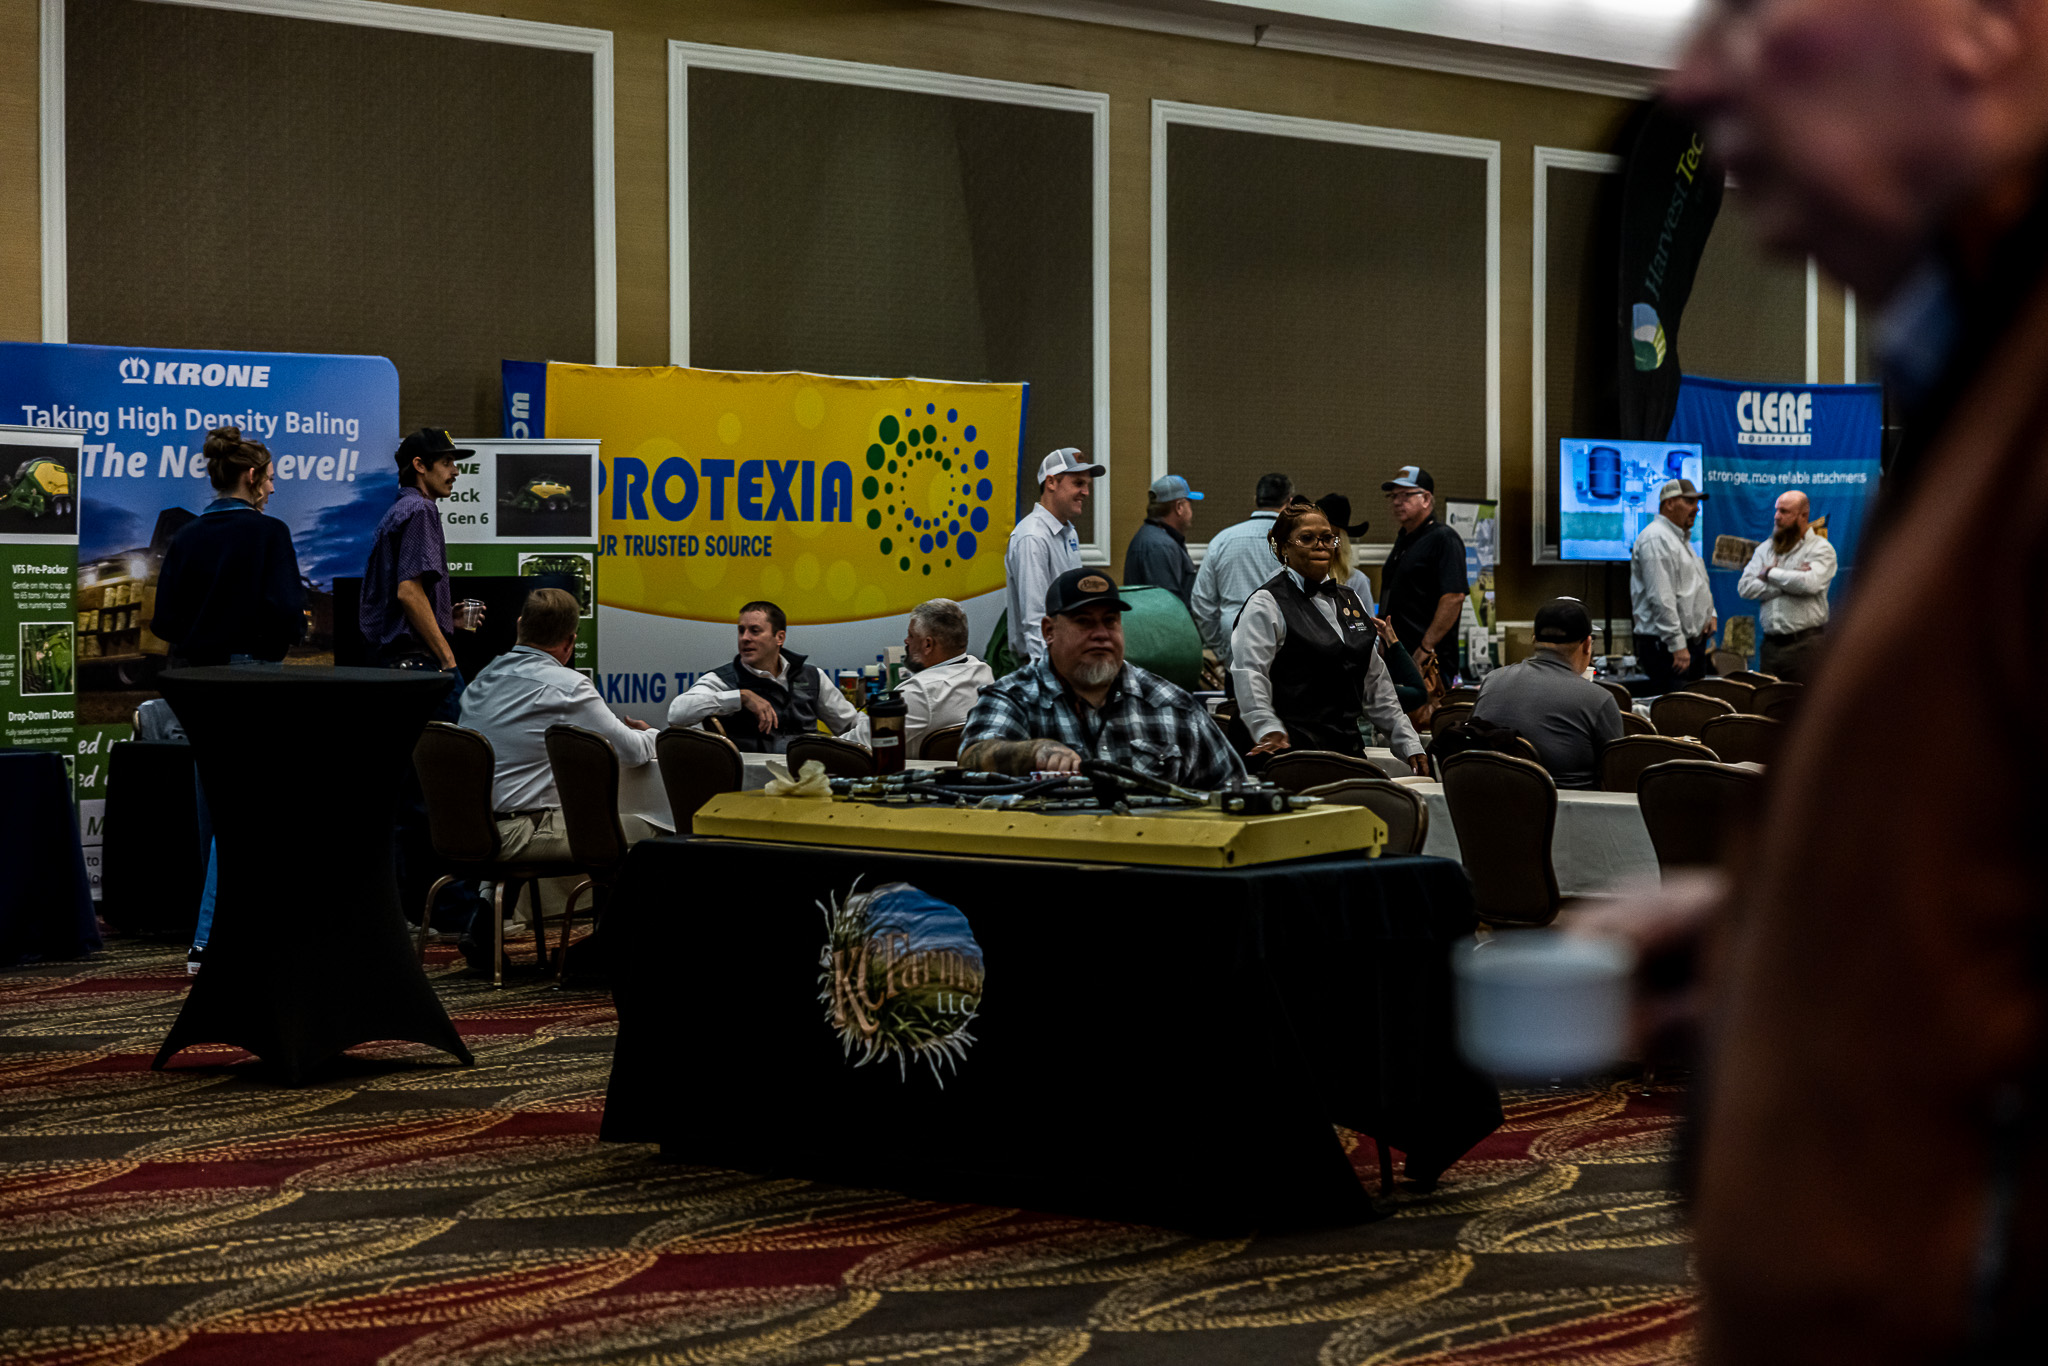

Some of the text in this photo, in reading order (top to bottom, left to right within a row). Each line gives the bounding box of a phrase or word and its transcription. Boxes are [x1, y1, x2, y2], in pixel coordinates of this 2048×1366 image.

[153, 362, 271, 388] KRONE
[1736, 390, 1812, 433] CLERF
[22, 405, 360, 442] Taking High Density Baling
[83, 442, 149, 478] The
[277, 448, 360, 482] evel!
[1752, 472, 1777, 484] more
[1778, 471, 1810, 484] reliable
[1811, 470, 1867, 484] attachments
[440, 488, 480, 502] ack
[598, 456, 853, 522] ROTEXIA
[447, 512, 476, 524] Gen
[480, 512, 489, 524] 6
[624, 535, 699, 557] TRUSTED
[705, 535, 772, 557] SOURCE
[12, 564, 69, 575] VFS Pre-Packer
[464, 562, 473, 571] II
[8, 709, 75, 724] Drop-Down Doors
[937, 991, 975, 1016] LLC
